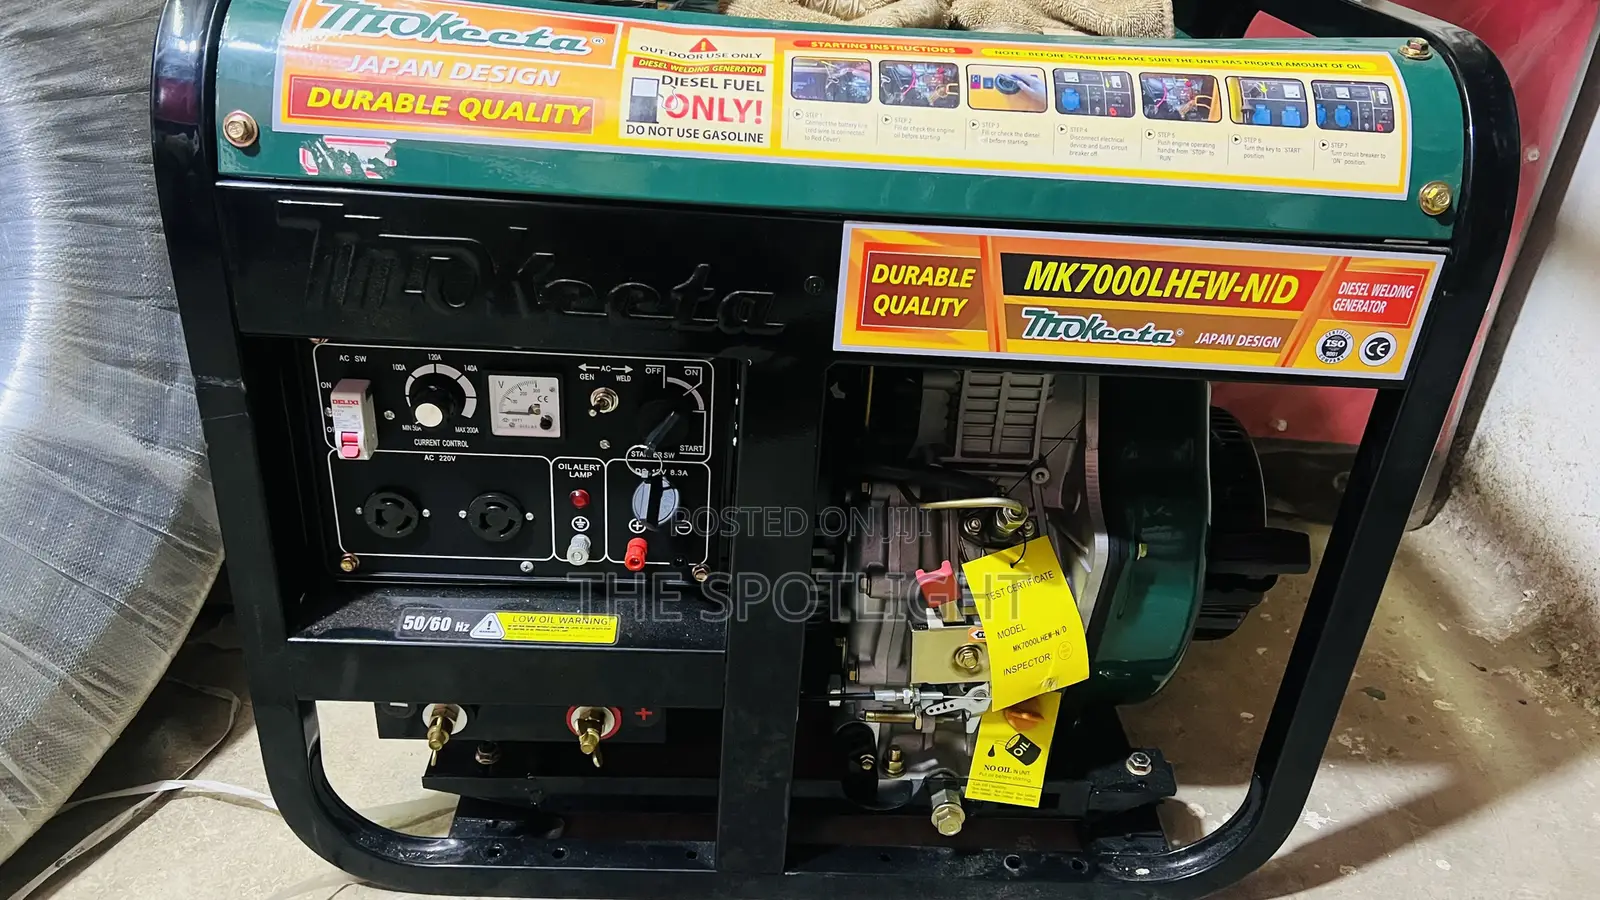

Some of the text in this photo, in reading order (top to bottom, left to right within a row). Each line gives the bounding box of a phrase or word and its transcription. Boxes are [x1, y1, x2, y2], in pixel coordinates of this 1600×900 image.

[811, 41, 955, 54] STARTING INSTRUCTIONS
[640, 45, 703, 60] OUT-DOOR
[349, 55, 561, 87] JAPAN DESIGN
[638, 59, 763, 74] DIESEL WELDING GENERATOR
[661, 75, 765, 92] DIESEL FUEL
[307, 86, 591, 126] DURABLE QUALITY
[665, 93, 763, 125] ONLY!
[626, 124, 764, 143] DO NOT USE GASOLINE
[871, 260, 1300, 305] DURABLE MK7000LHEW-N/D
[1337, 281, 1416, 300] DIESEL WELDING
[872, 294, 969, 318] QUALITY
[1332, 298, 1388, 314] GENERATOR
[1195, 332, 1235, 347] JAPAN
[1236, 334, 1282, 348] DESIGN
[1325, 339, 1346, 348] ISO
[339, 354, 367, 363] AC SW
[427, 353, 442, 361] 120A
[392, 364, 406, 372] 100A
[463, 364, 478, 372] 140A
[600, 365, 611, 373] AC
[645, 367, 662, 375] OFF
[684, 368, 699, 376] ON
[579, 373, 595, 381] GEN
[616, 374, 632, 383] WELD
[320, 381, 332, 389] ON
[498, 380, 505, 389] V
[402, 424, 412, 432] MIN
[455, 426, 466, 434] MAX
[414, 438, 469, 448] CURRENT CONTROL
[424, 454, 457, 463] AC 220V
[630, 451, 664, 459] STAER
[570, 463, 601, 472] ALERT
[569, 470, 593, 478] LAMP
[669, 469, 688, 477] 8.3A
[985, 570, 1055, 601] TEST CERTIFICATE
[402, 614, 471, 633] 50/60 Hz
[512, 615, 537, 623] LOW
[538, 616, 556, 624] OIL
[996, 624, 1026, 640] MODEL
[1012, 625, 1068, 653] MK7000LHEW-N/D
[1012, 741, 1032, 757] OIL
[983, 764, 1012, 773] NO OIL
